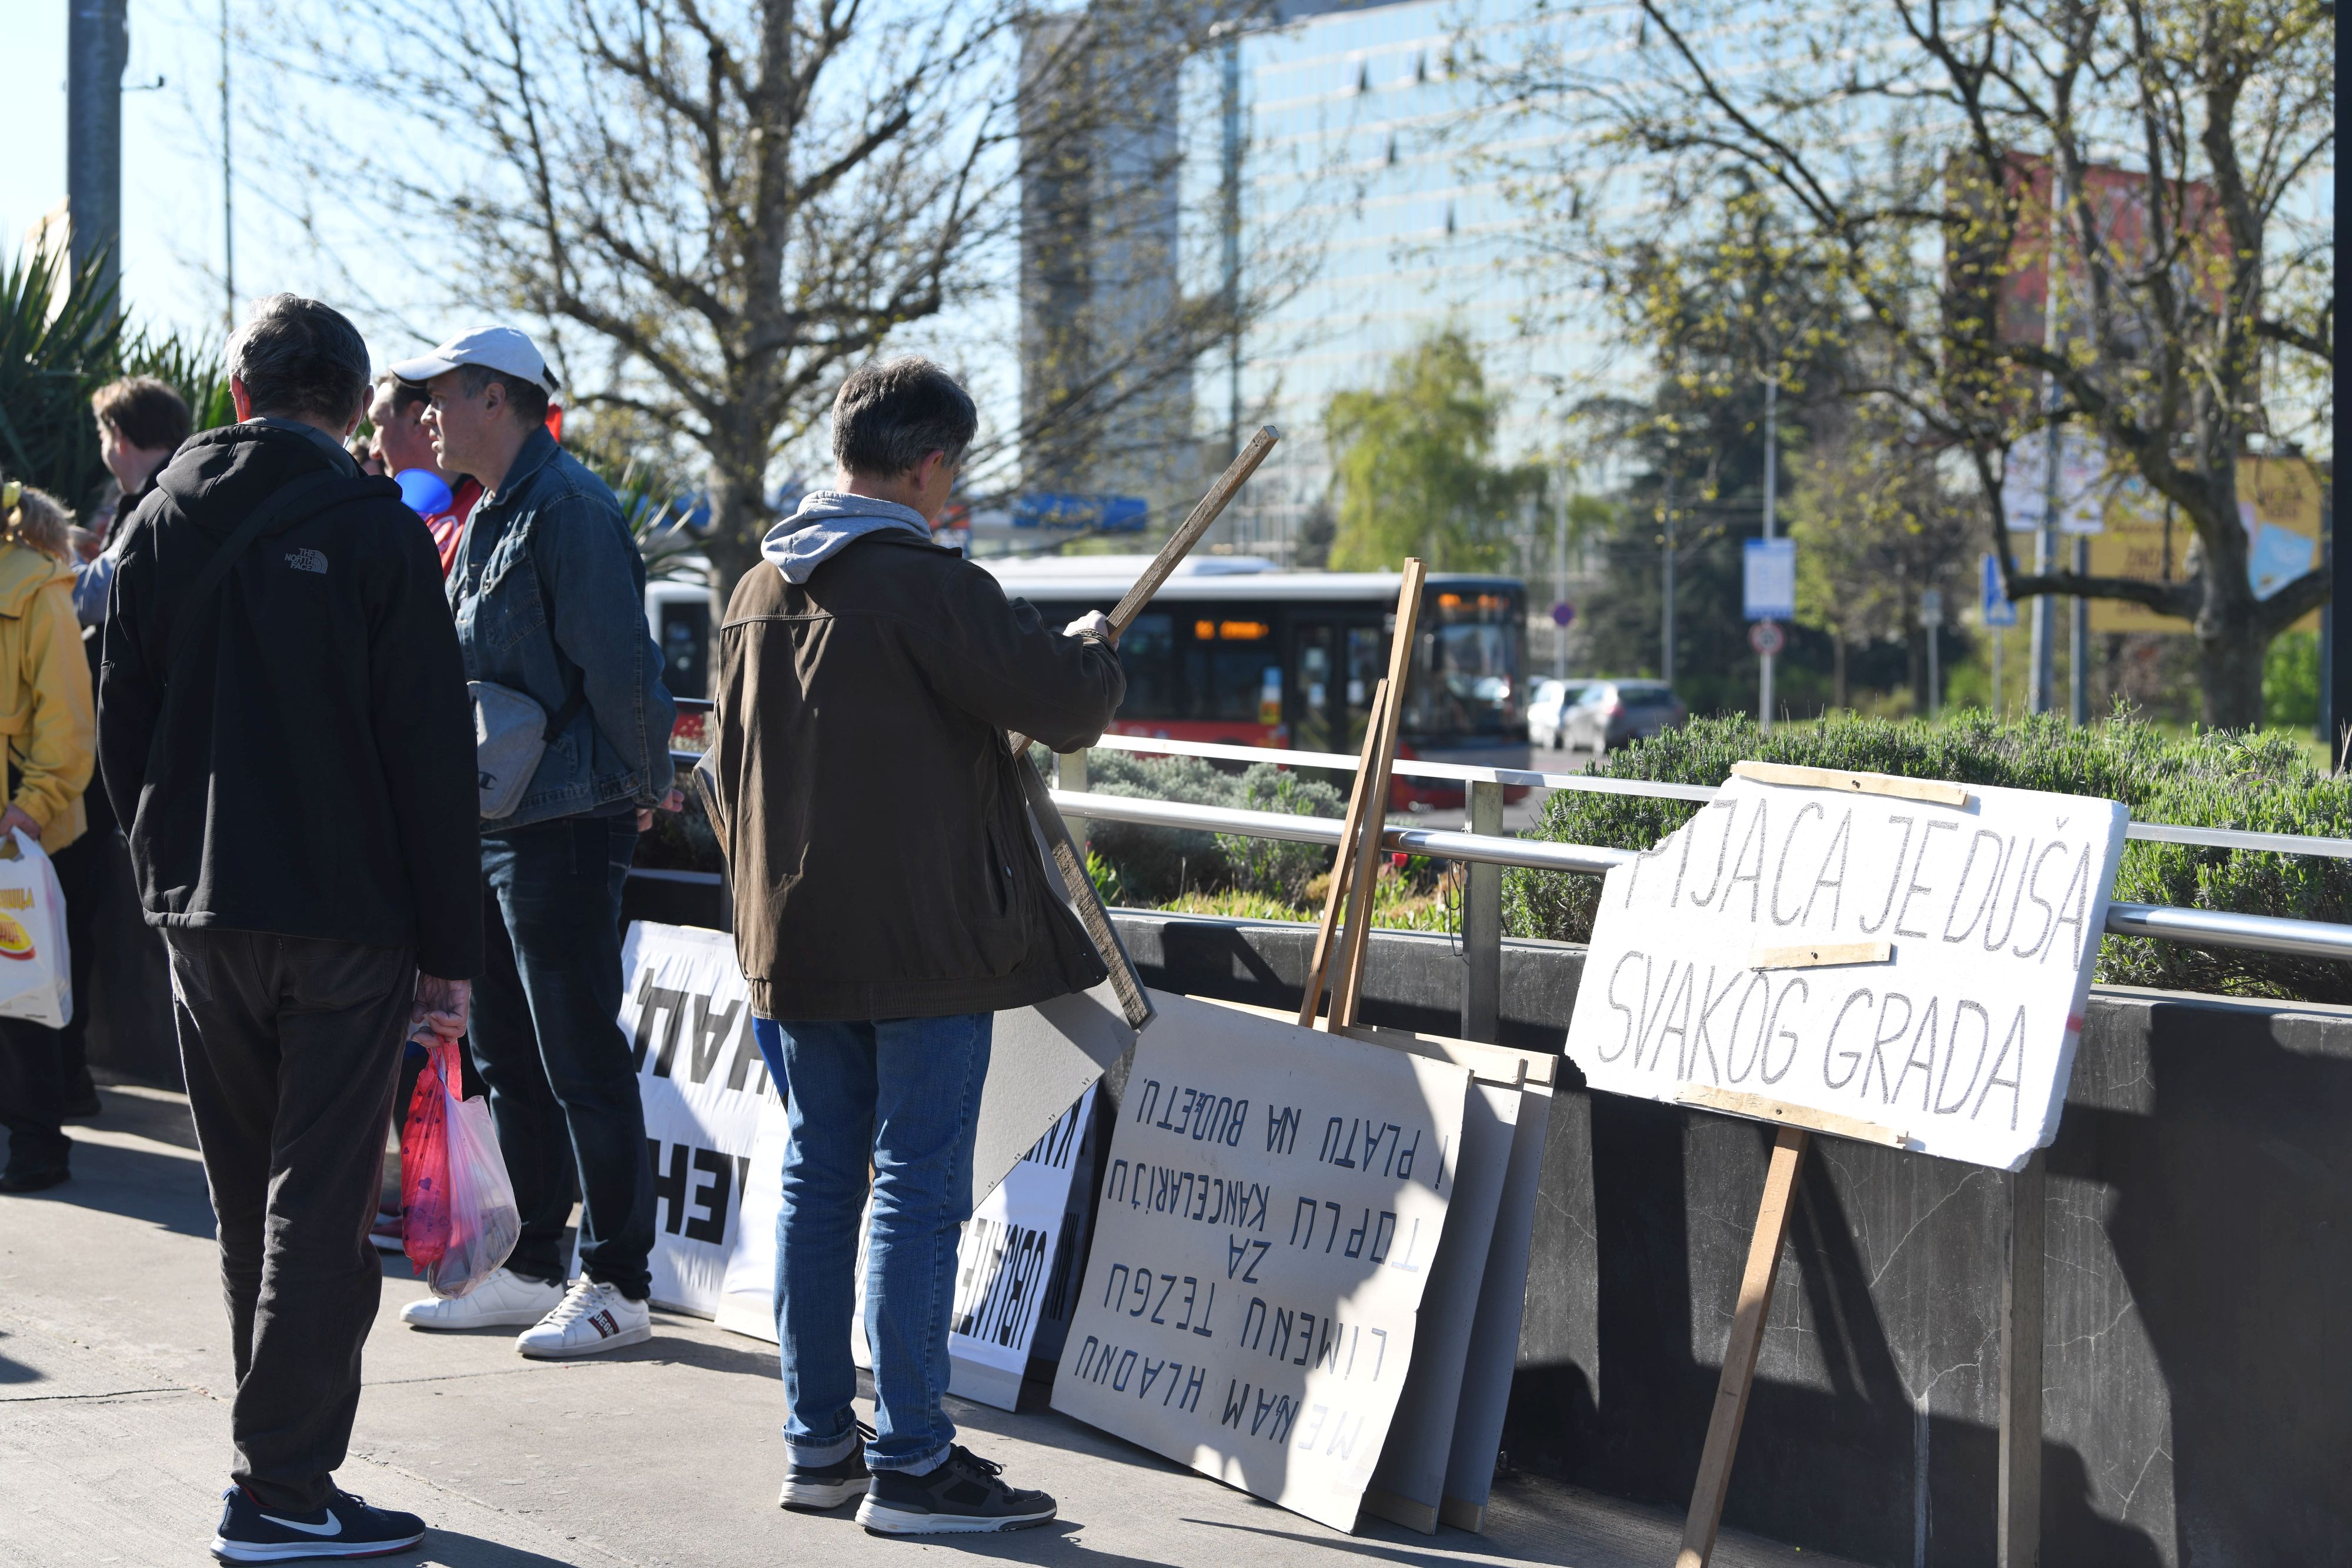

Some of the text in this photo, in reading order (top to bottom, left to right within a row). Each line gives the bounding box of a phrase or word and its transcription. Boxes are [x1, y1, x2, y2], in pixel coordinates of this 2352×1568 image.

[284, 553, 314, 564] NORTH
[290, 561, 312, 571] FACE
[299, 547, 315, 557] THE
[1859, 815, 1958, 939] JE
[1942, 816, 2090, 972] DUŠA
[1598, 950, 2026, 1131] SVAKOG GRADA
[1266, 1104, 1301, 1155] NA
[1319, 1117, 1421, 1180] PLATU
[1107, 1159, 1419, 1273] TOPLU KANCELARIJU
[1228, 1233, 1271, 1285] ZA
[1103, 1263, 1214, 1338] TEZGU
[1241, 1297, 1388, 1382] LIMENU
[1074, 1336, 1205, 1413] HLADNU
